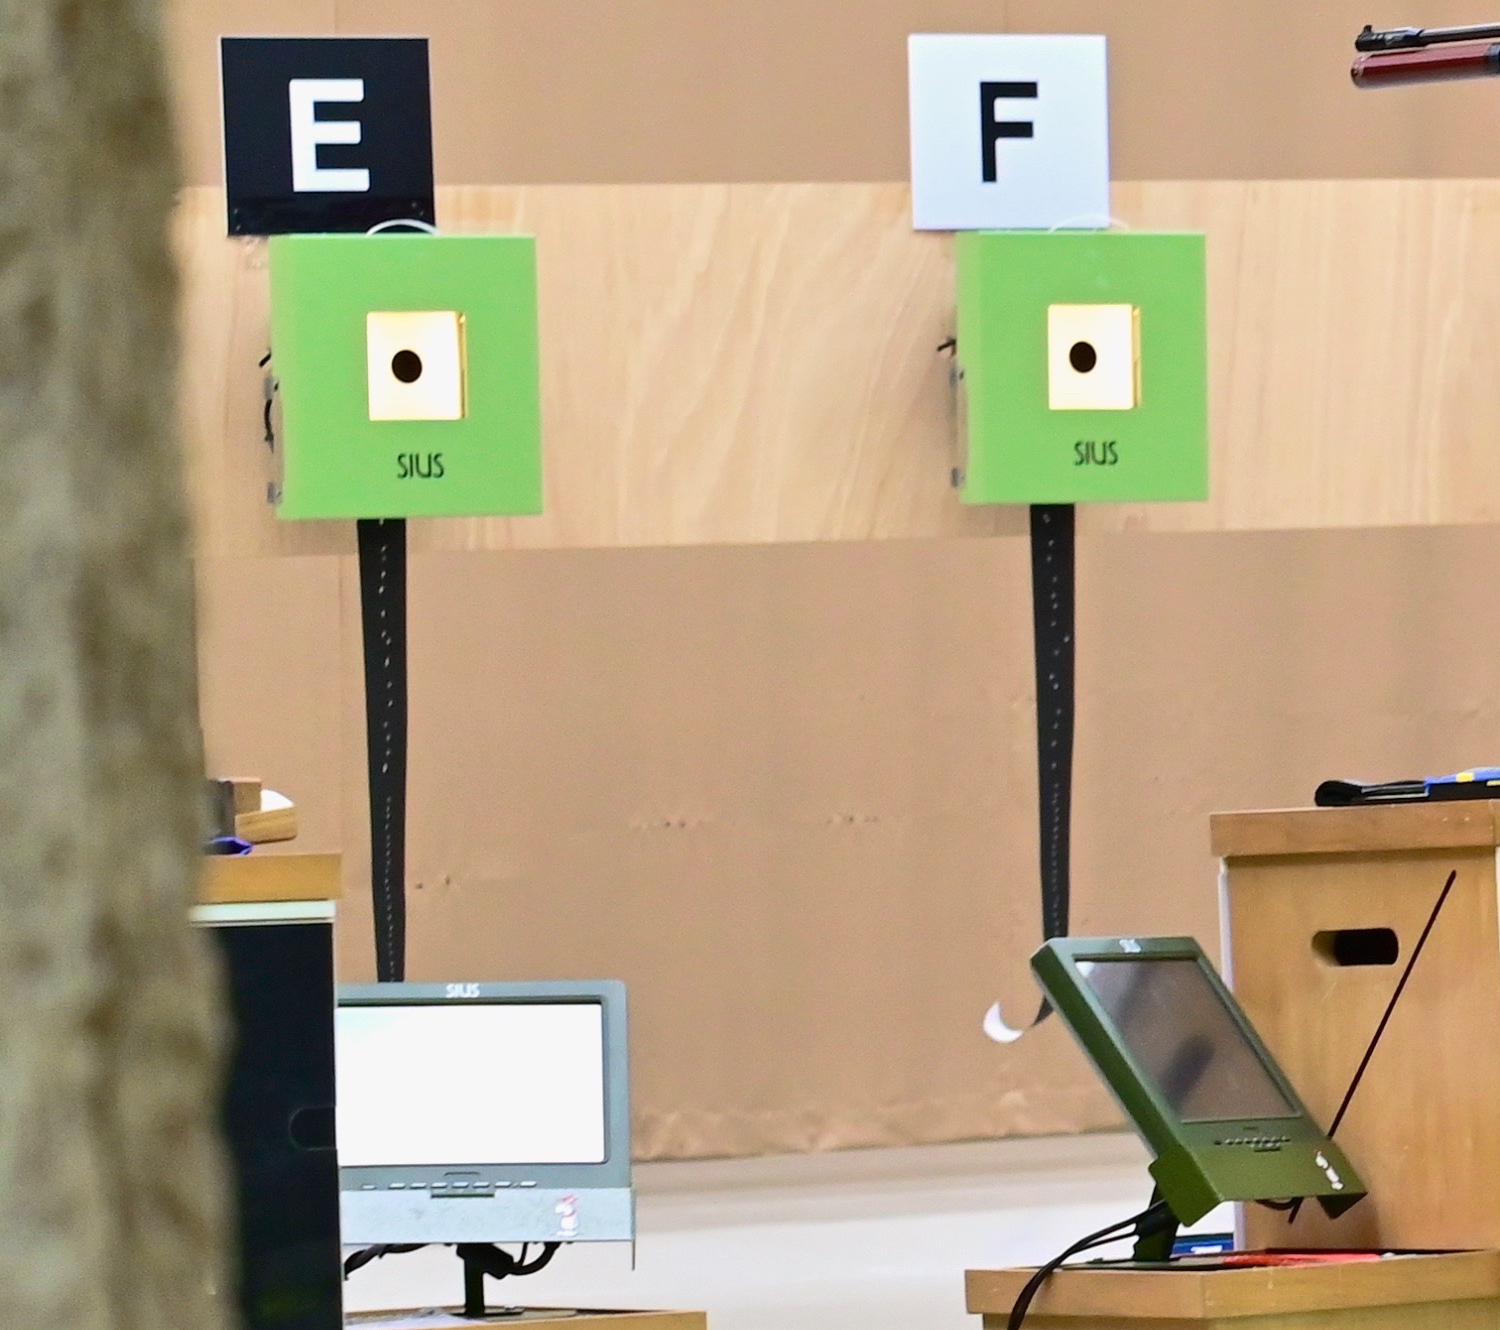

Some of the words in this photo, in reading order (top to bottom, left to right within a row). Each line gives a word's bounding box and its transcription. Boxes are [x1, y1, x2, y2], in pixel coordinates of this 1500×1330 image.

[289, 78, 370, 192] E
[979, 81, 1038, 183] F
[396, 452, 445, 479] SIUS
[1073, 440, 1119, 467] SIUS
